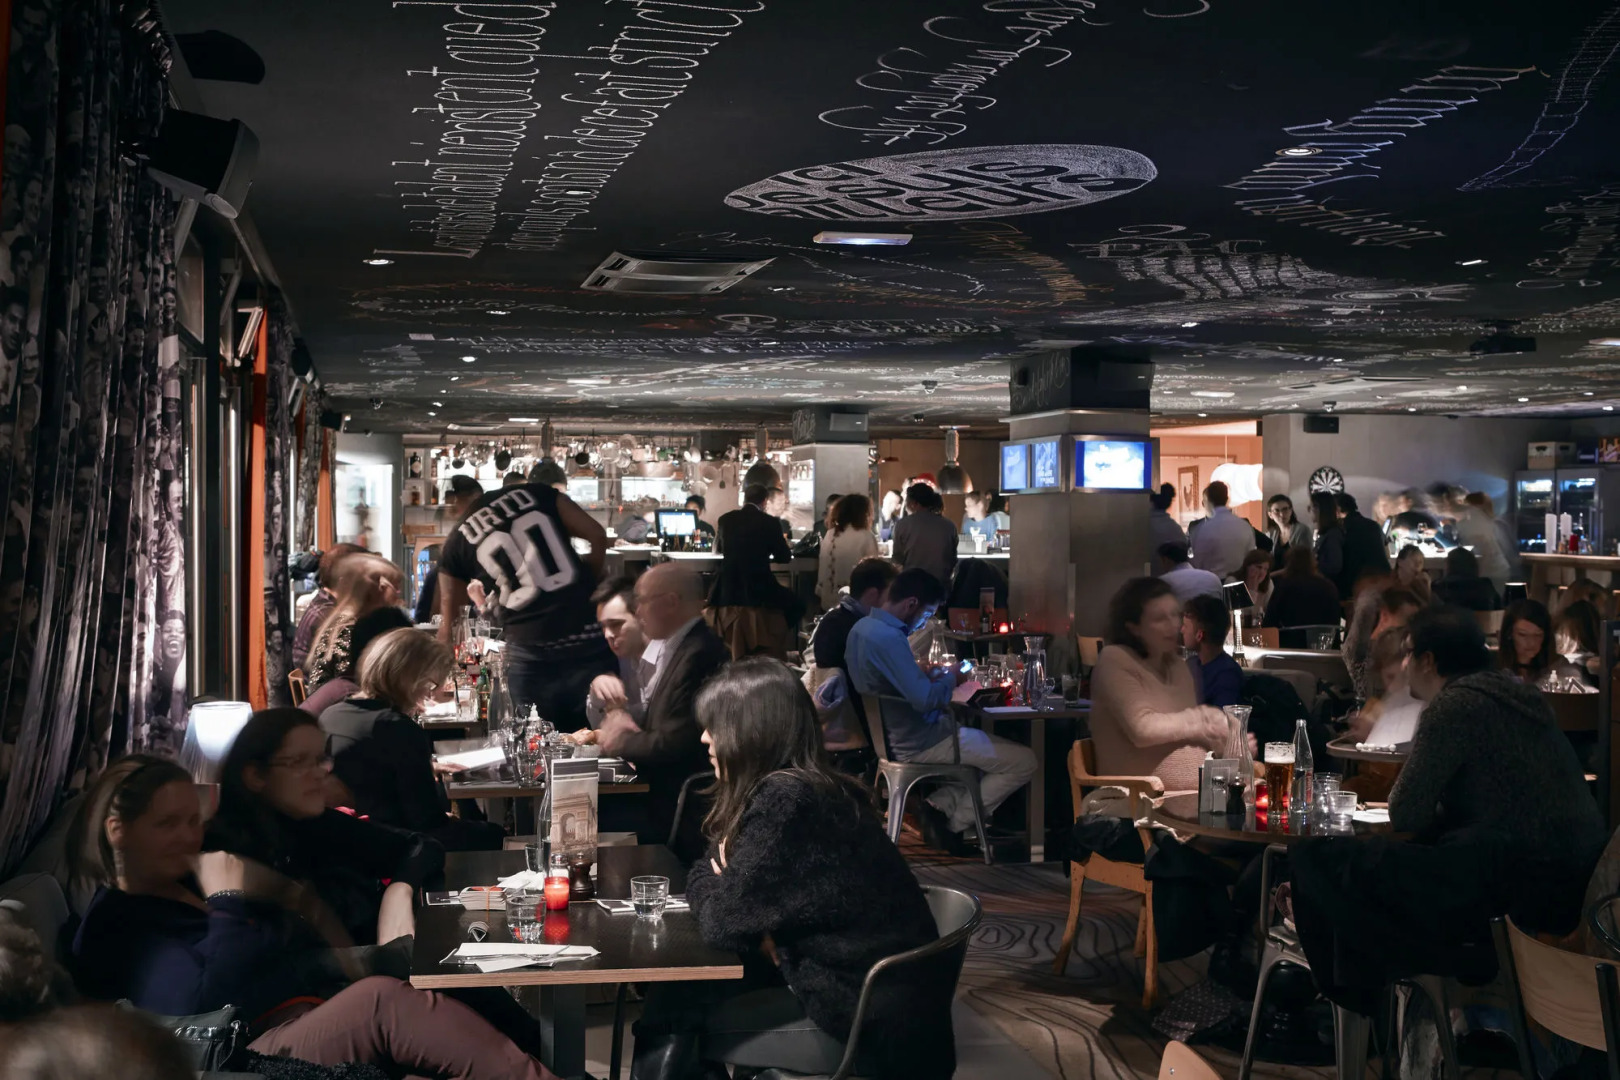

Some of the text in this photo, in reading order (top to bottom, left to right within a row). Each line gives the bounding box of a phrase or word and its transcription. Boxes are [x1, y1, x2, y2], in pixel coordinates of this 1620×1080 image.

[560, 71, 694, 108] fait
[543, 127, 648, 148] de
[391, 158, 515, 198] talent
